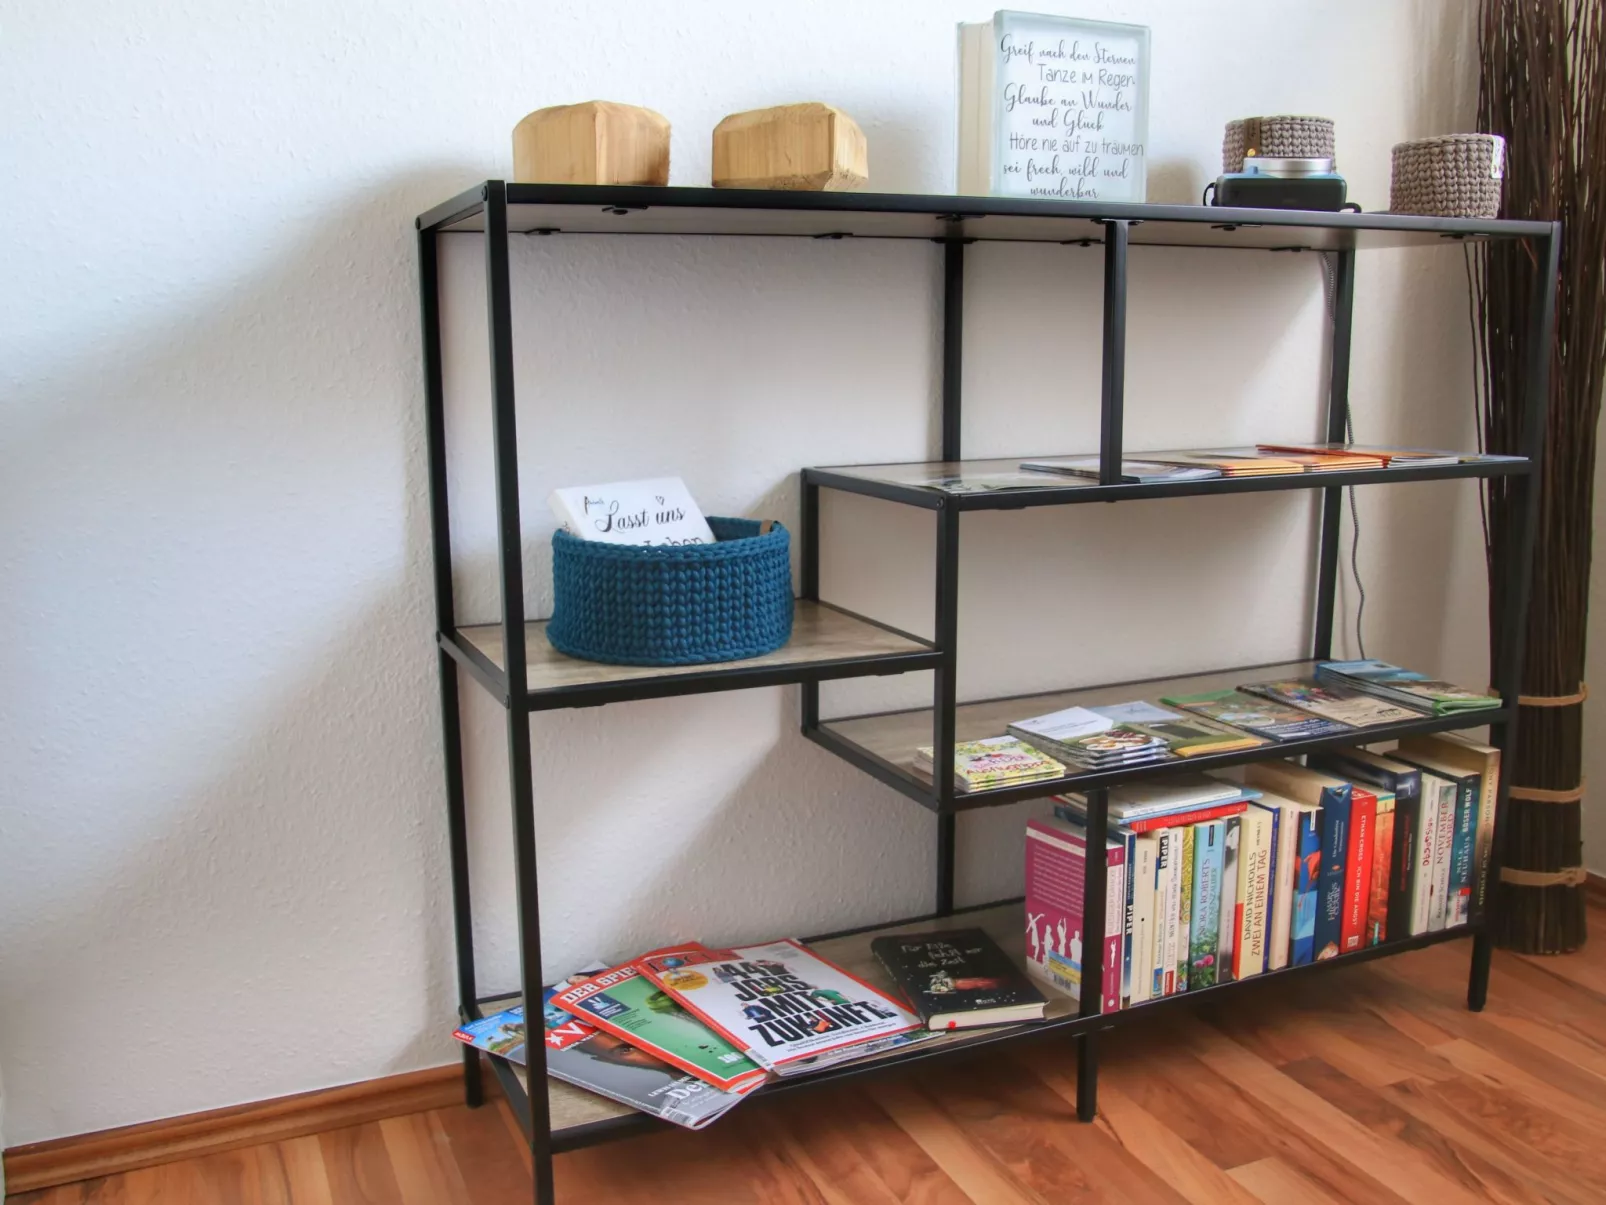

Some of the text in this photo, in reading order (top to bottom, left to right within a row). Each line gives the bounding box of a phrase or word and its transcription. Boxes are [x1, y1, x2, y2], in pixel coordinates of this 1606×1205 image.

[1000, 33, 1136, 65] Greif nach den Sternen
[1038, 63, 1076, 83] Tanze
[1099, 68, 1136, 91] Regen
[1004, 82, 1131, 112] Glaube an Wunder
[1032, 108, 1058, 129] und
[1010, 133, 1037, 151] Höre
[1062, 137, 1081, 153] auf
[1084, 143, 1097, 154] zu
[1003, 162, 1021, 174] sei
[1068, 156, 1099, 178] wild
[1103, 159, 1129, 179] und
[1030, 177, 1100, 199] wunderbar
[595, 500, 650, 533] Lasst
[655, 507, 685, 525] uns
[1464, 787, 1473, 808] WOLF
[1359, 814, 1367, 838] ETHAN
[1436, 801, 1449, 864] NOVEMBER
[1445, 813, 1454, 849] MORD
[1159, 838, 1169, 869] PIPER
[1459, 836, 1471, 883] NEUHAUS
[1197, 858, 1210, 935] NORA ROBERTS
[1243, 852, 1256, 941] DAVID NICHOLLS
[1251, 849, 1267, 956] ZWEI AN EINEM TAG
[1125, 904, 1133, 935] PIPER
[721, 959, 769, 979] 44
[560, 983, 600, 1003] DER
[730, 974, 811, 1001] JOBS
[758, 990, 827, 1019] MIT
[748, 1001, 890, 1047] ZUKUNFT
